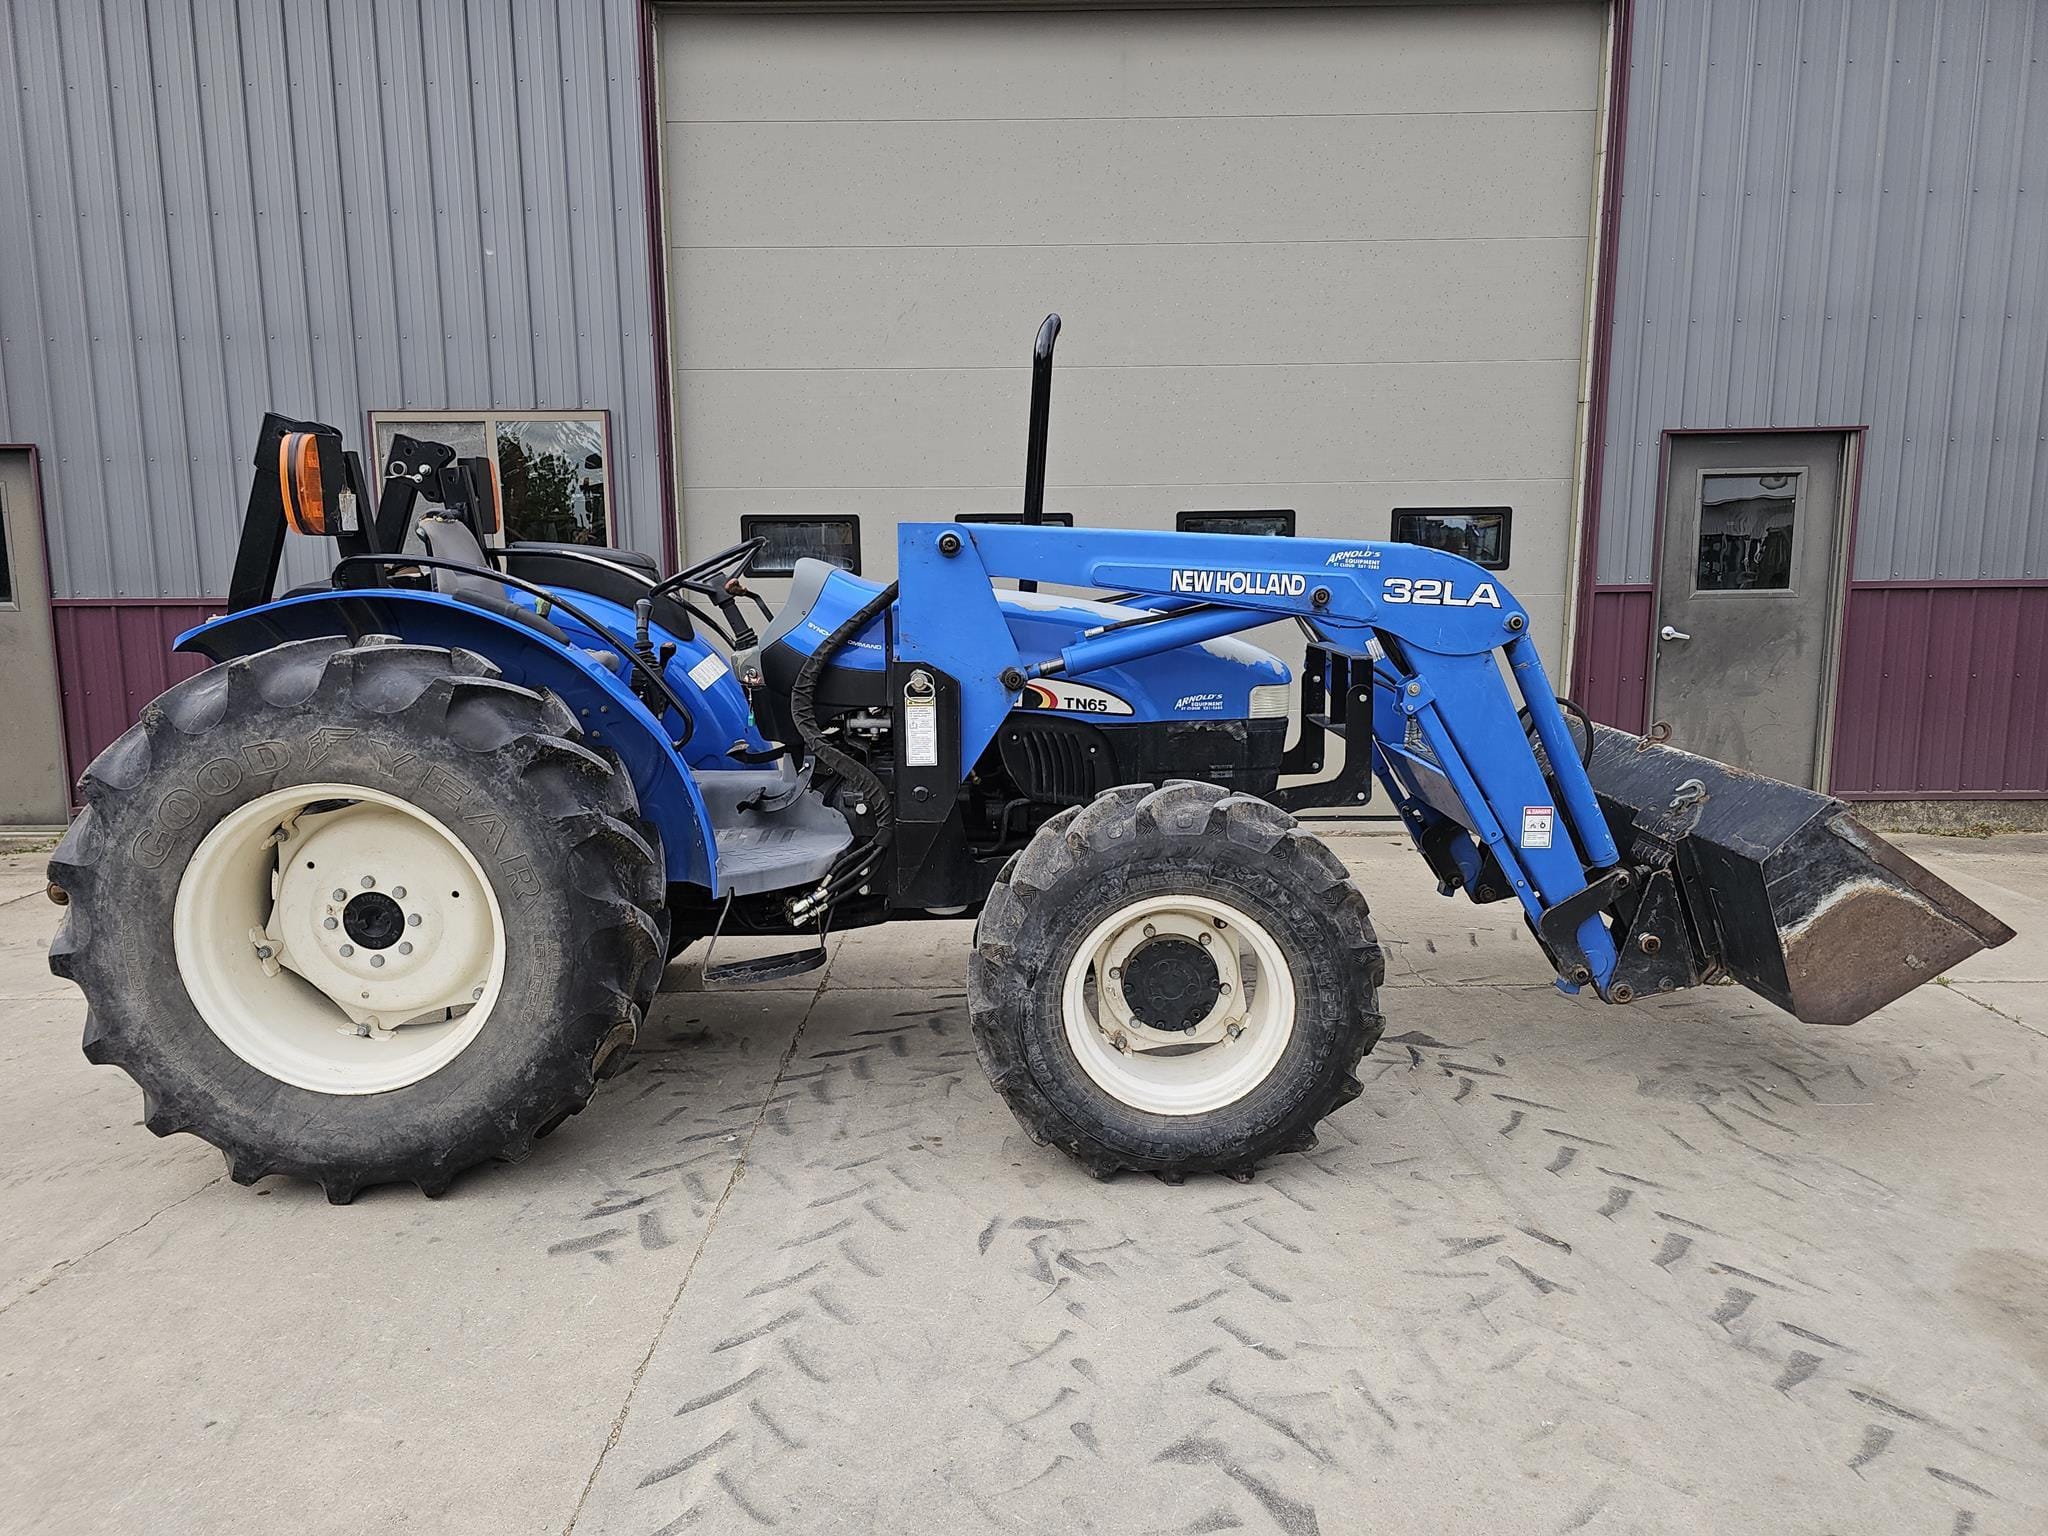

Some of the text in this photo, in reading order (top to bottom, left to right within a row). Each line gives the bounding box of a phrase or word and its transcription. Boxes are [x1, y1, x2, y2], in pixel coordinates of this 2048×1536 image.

[1325, 550, 1381, 566] ARNOLD'S
[1171, 569, 1306, 596] NEW HOLLAND
[1382, 578, 1502, 609] 32LA
[807, 622, 882, 650] SYNC OMMAND
[1063, 697, 1108, 712] TN65
[1174, 693, 1223, 710] ARNOLD'S
